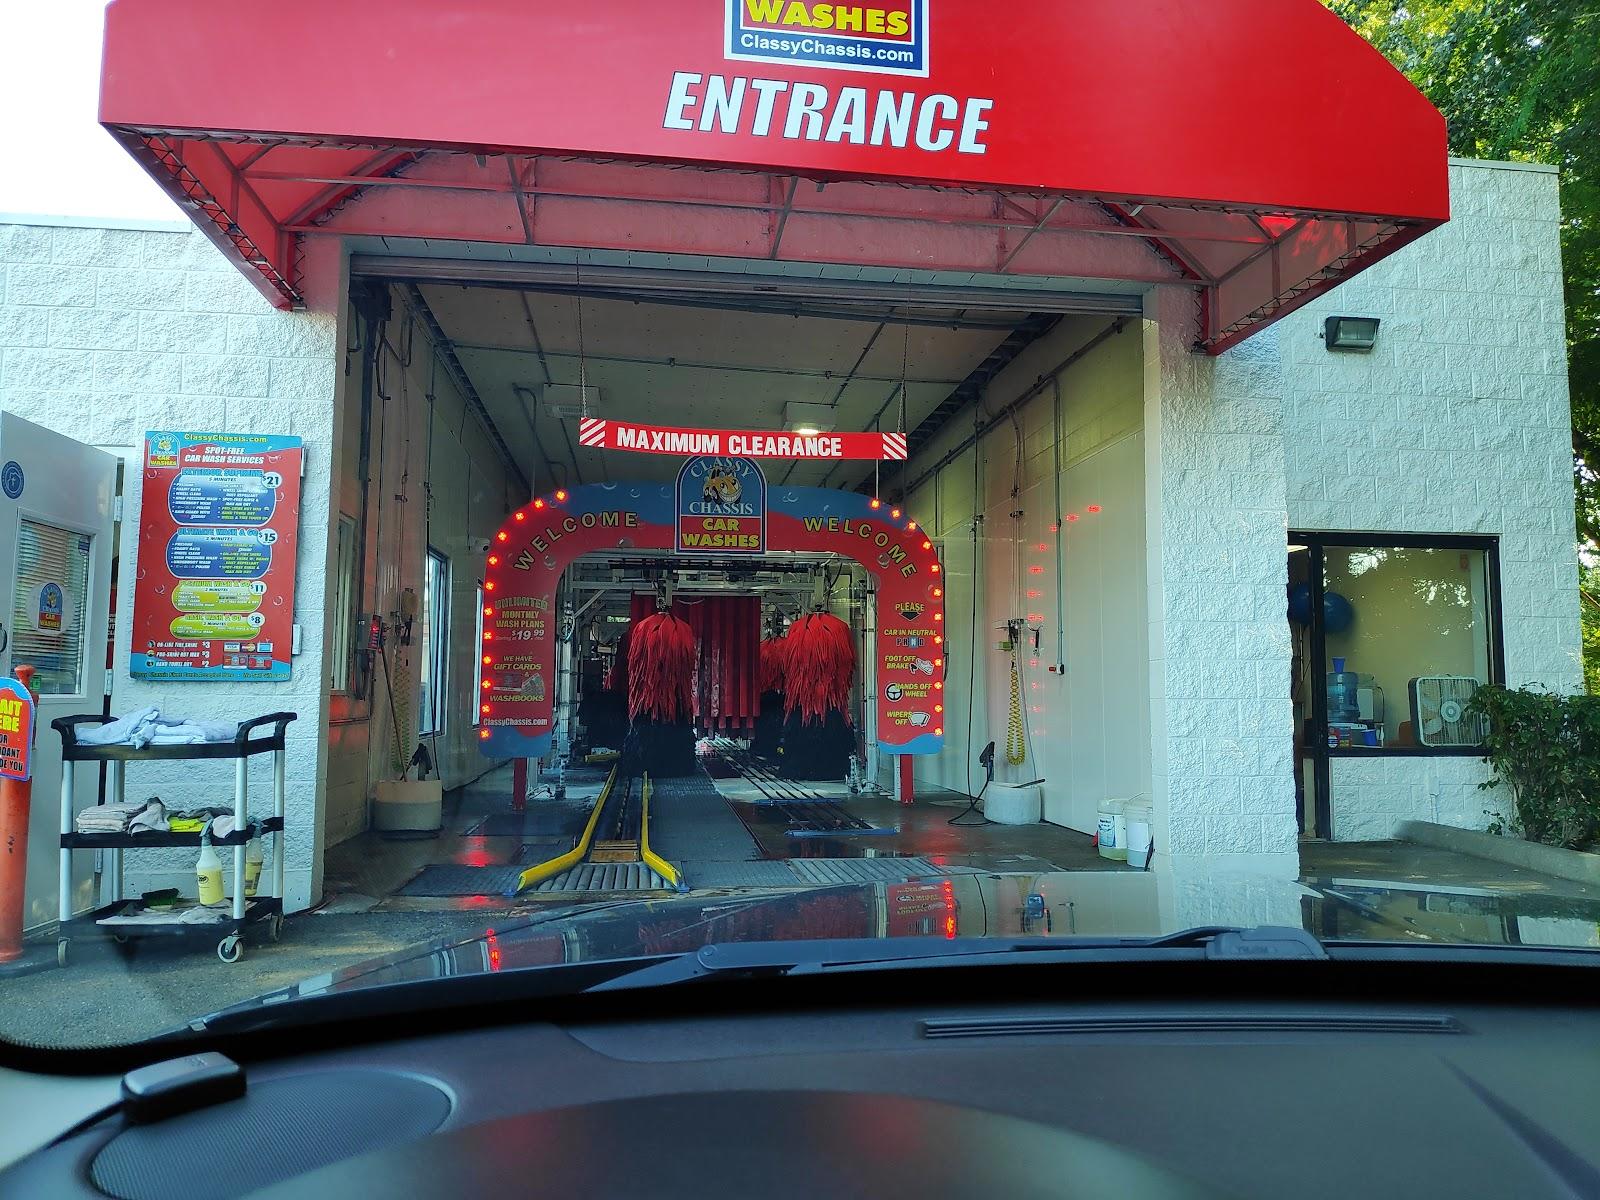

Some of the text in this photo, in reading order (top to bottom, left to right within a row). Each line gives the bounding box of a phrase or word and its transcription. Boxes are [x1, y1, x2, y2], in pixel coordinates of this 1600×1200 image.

[746, 0, 908, 36] WASHES
[740, 34, 914, 62] ClassyChassis.com
[663, 70, 994, 154] ENTRANCE
[185, 434, 267, 442] ClassyChassis.com
[617, 427, 842, 456] MAXIMUM CLEARANCE
[690, 456, 753, 478] CLASSY
[262, 476, 279, 485] $21
[689, 502, 753, 516] CHASSIS
[702, 518, 740, 532] CAR
[259, 532, 276, 542] $15
[513, 511, 638, 572] WELCOME
[682, 534, 760, 548] WASHES
[804, 517, 917, 578] WELCOME
[495, 596, 548, 610] UNLIMITED
[895, 602, 925, 611] PLEASE
[0, 699, 22, 716] AIT
[483, 718, 548, 726] ClassyChassis.com
[0, 747, 20, 758] DANT
[10, 760, 22, 771] YOU
